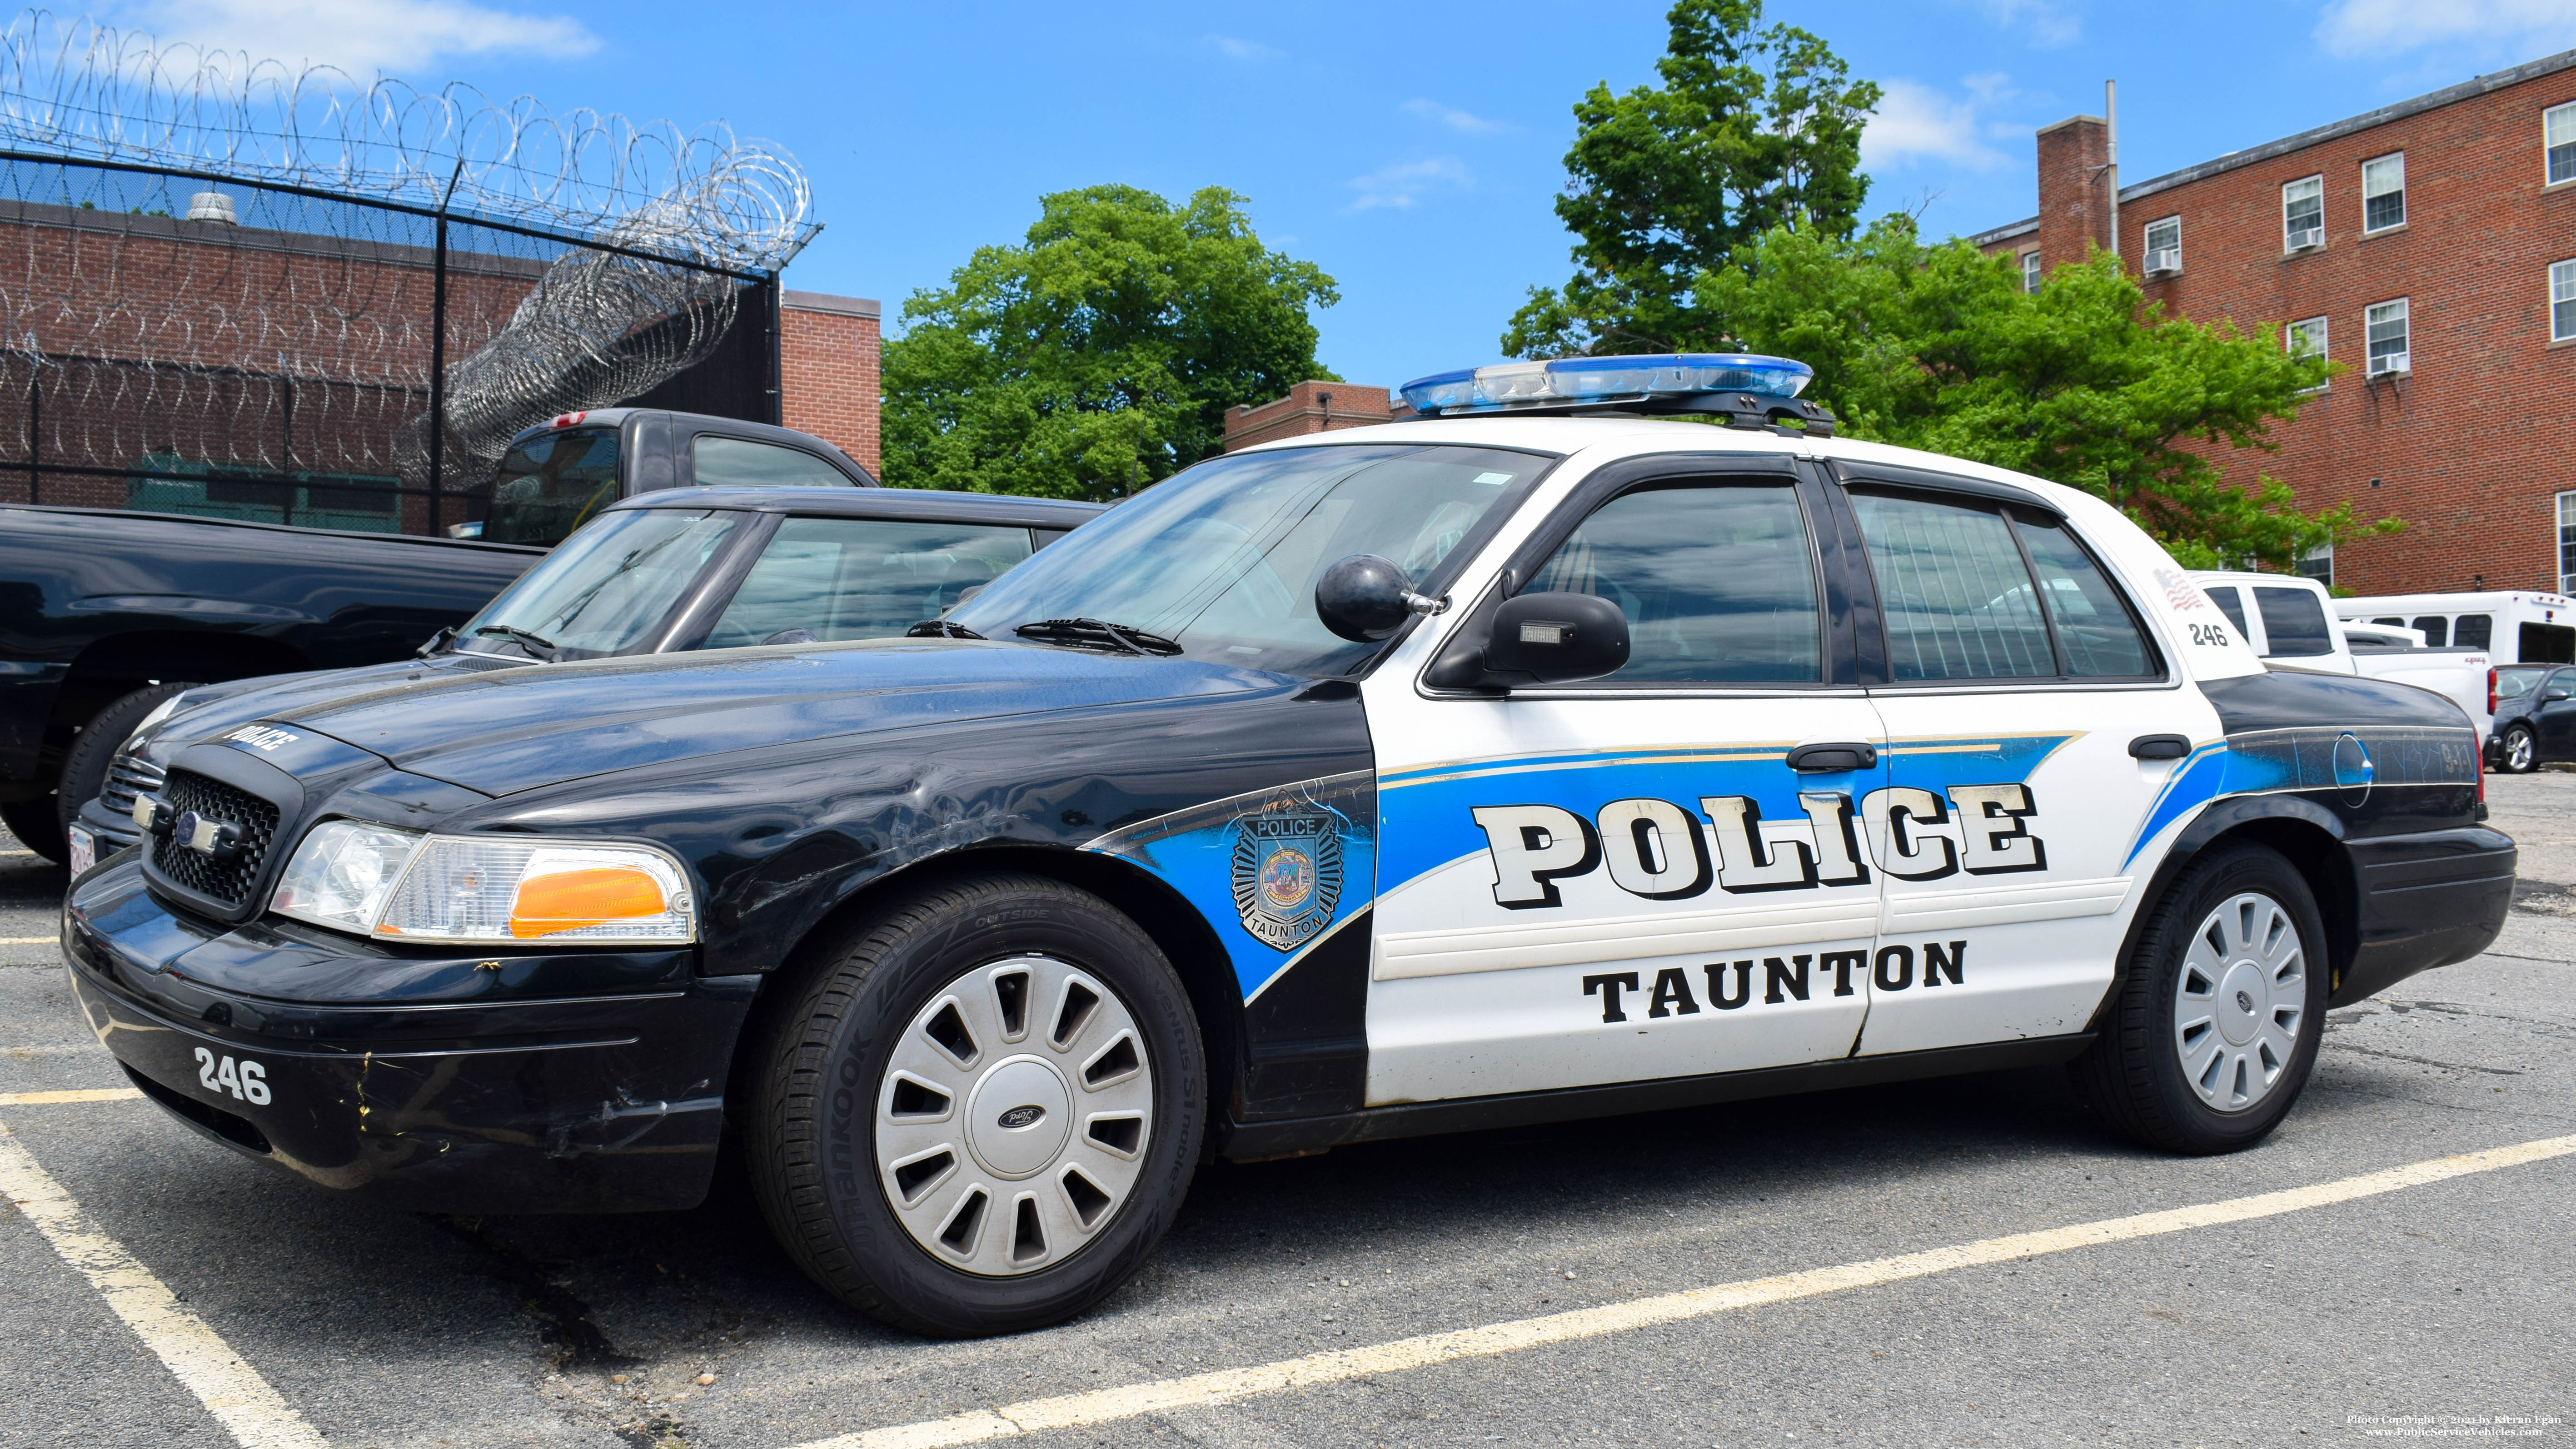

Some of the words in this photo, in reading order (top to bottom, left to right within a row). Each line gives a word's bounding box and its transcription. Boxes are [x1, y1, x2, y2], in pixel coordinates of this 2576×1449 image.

[2188, 623, 2228, 647] 246
[222, 726, 299, 751] POLICE
[1257, 819, 1317, 837] POLICE
[1470, 783, 2048, 911] POLICE
[975, 909, 1048, 928] OUTSIDE
[1251, 915, 1323, 938] TAUNTON
[1583, 940, 1968, 1024] TAUNTON
[194, 1047, 272, 1105] 246
[1009, 1110, 1033, 1124] Ford
